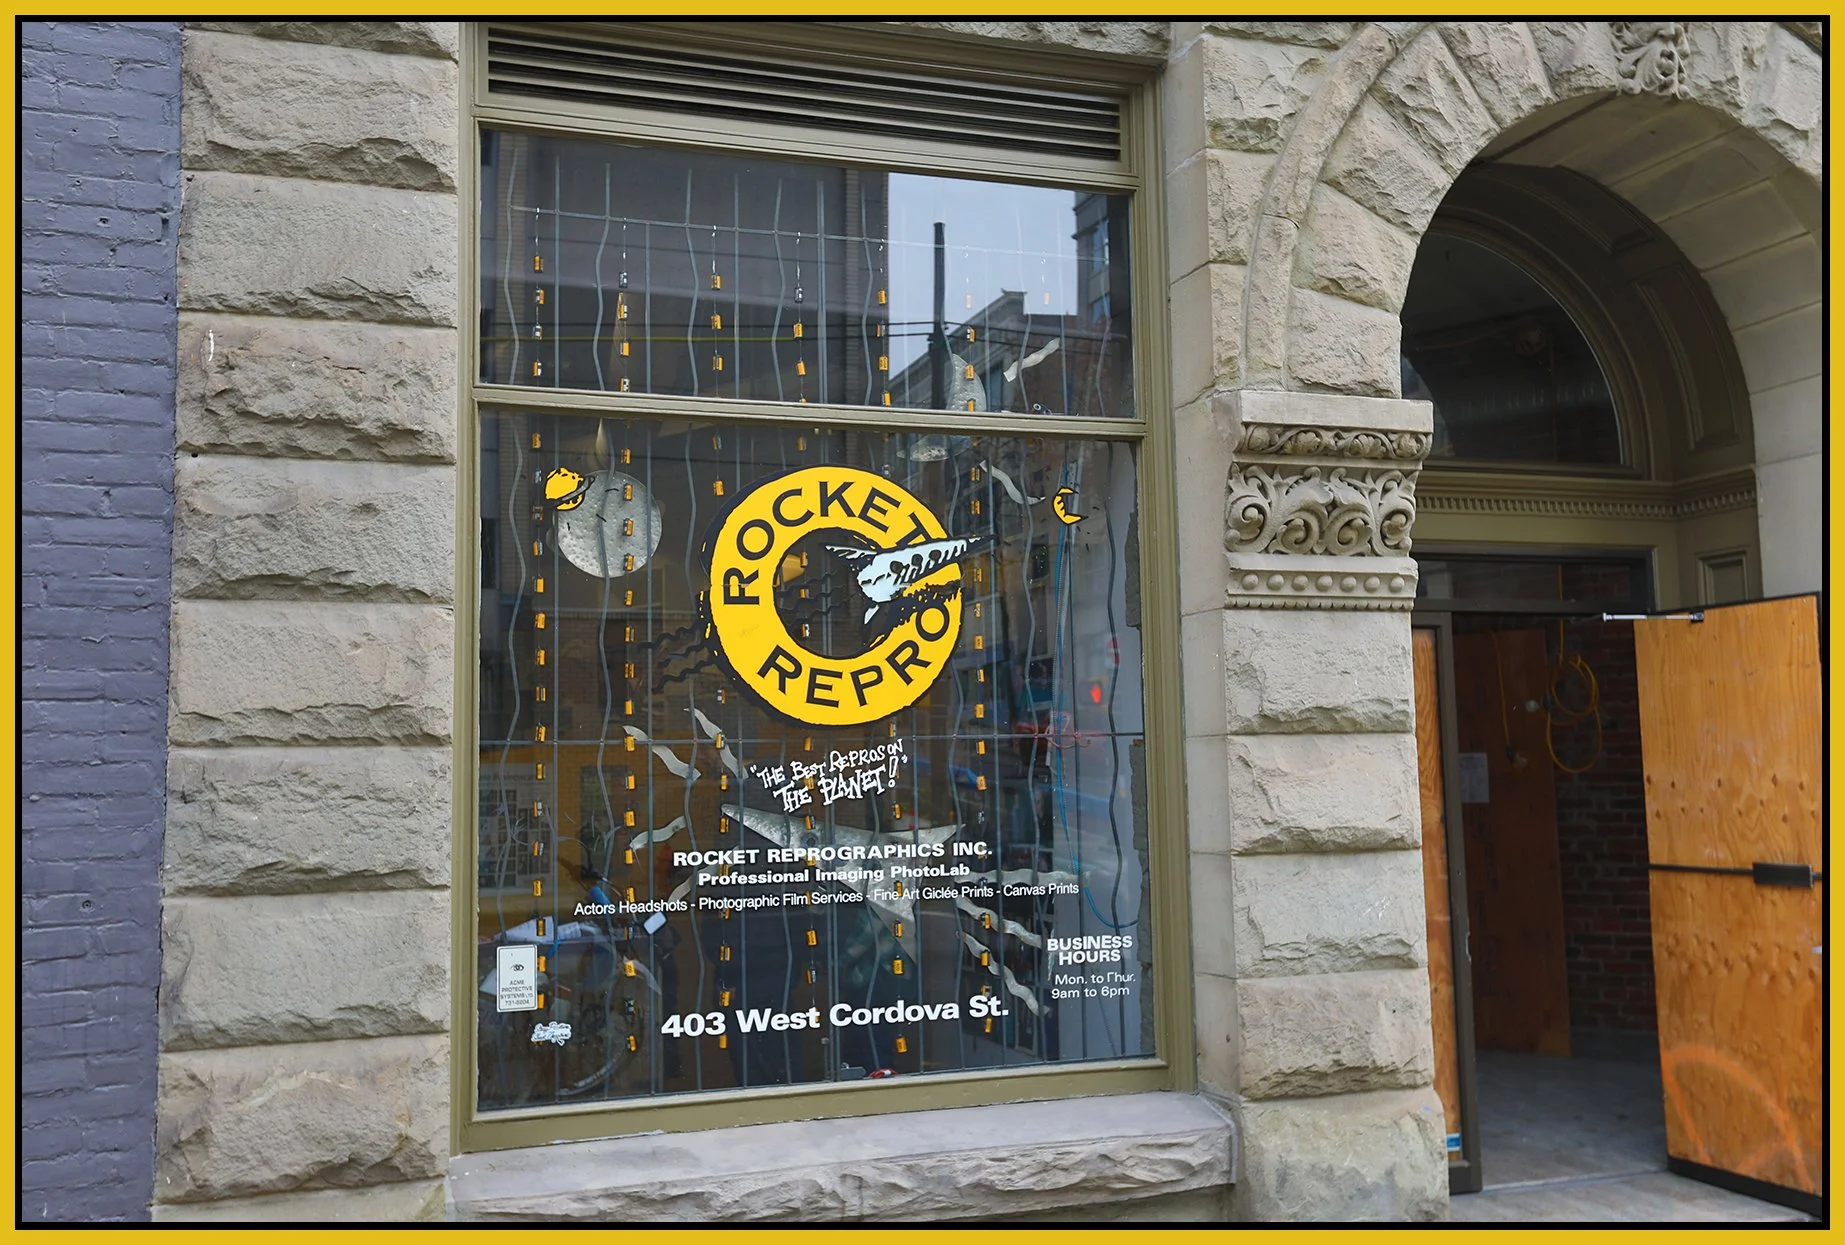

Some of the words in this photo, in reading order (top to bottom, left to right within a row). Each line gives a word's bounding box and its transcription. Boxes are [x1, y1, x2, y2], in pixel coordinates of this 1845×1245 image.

[723, 481, 932, 605] ROCKET
[757, 602, 950, 708] REPRO
[829, 744, 886, 773] REPROS
[887, 738, 903, 756] ON
[773, 780, 812, 813] THE
[673, 849, 760, 867] ROCKET
[767, 843, 945, 864] REPROGRAPHICS
[953, 841, 993, 856] INC.
[699, 869, 809, 886] Professional
[815, 866, 884, 882] Imaging
[890, 863, 970, 879] PhotoLab
[574, 901, 616, 916] Actors
[619, 898, 688, 914] Headshots
[699, 895, 780, 912] Photographic
[783, 893, 809, 906] Film
[811, 891, 864, 905] Services
[873, 889, 898, 901] Fine
[901, 888, 920, 900] Art
[922, 885, 959, 899] Giclée
[961, 884, 994, 898] Prints
[1003, 883, 1046, 896] Canvas
[1048, 882, 1080, 895] Prints
[1047, 935, 1133, 951] BUSINESS
[1058, 949, 1121, 965] HOURS
[1051, 987, 1080, 999] 9am
[1084, 987, 1097, 997] to
[1101, 985, 1130, 998] 6pm
[1055, 974, 1088, 985] Mon.
[1091, 974, 1104, 984] to
[661, 1012, 727, 1038] 403
[735, 1007, 820, 1033] West
[829, 1000, 960, 1027] Cordova
[969, 994, 1010, 1018] St.
